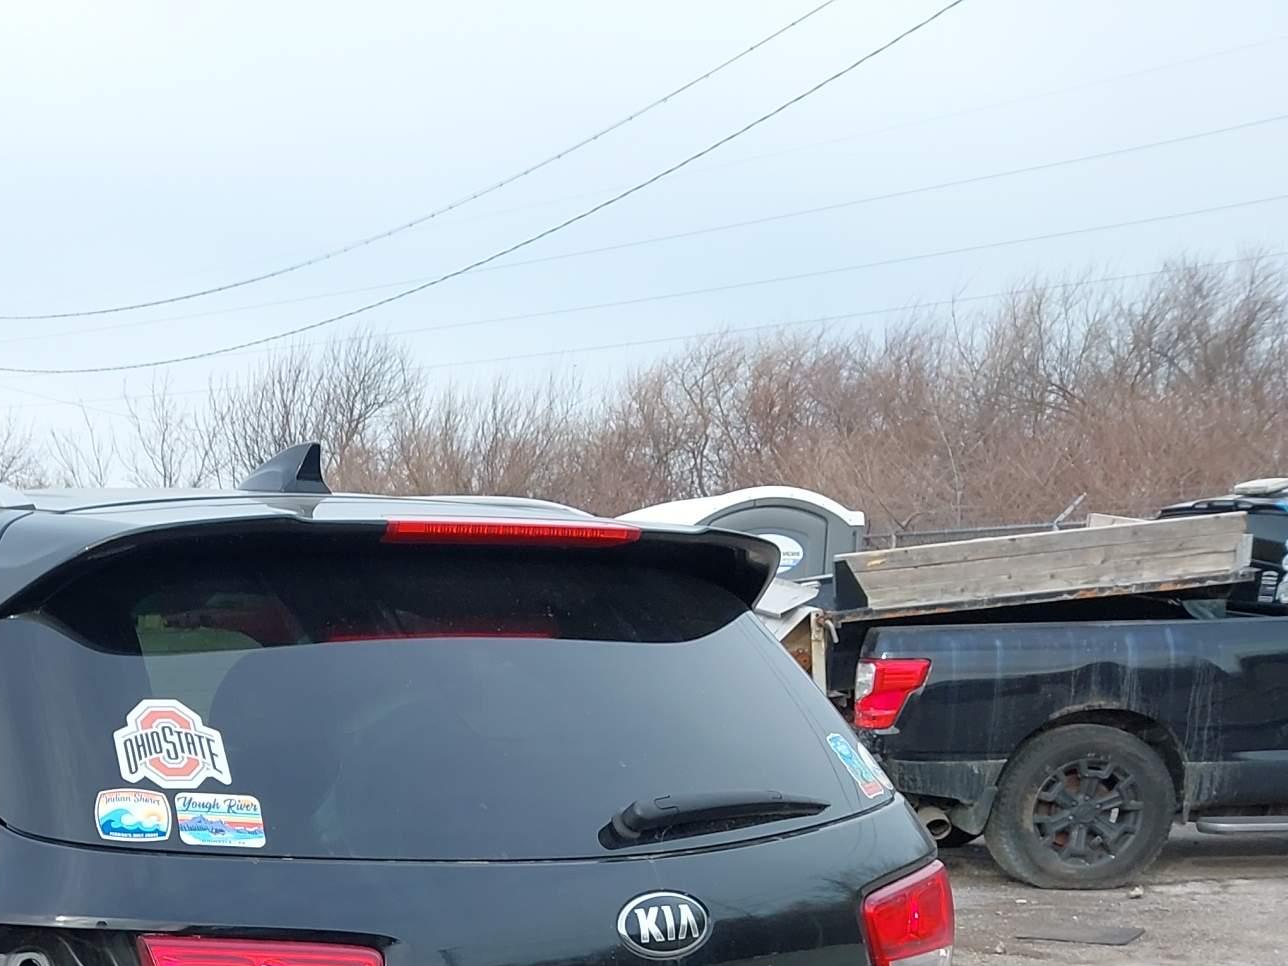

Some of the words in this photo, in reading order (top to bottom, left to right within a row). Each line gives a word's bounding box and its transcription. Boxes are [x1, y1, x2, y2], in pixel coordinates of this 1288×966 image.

[177, 796, 221, 813] Yough
[224, 799, 259, 814] River
[634, 904, 699, 943] KIA
